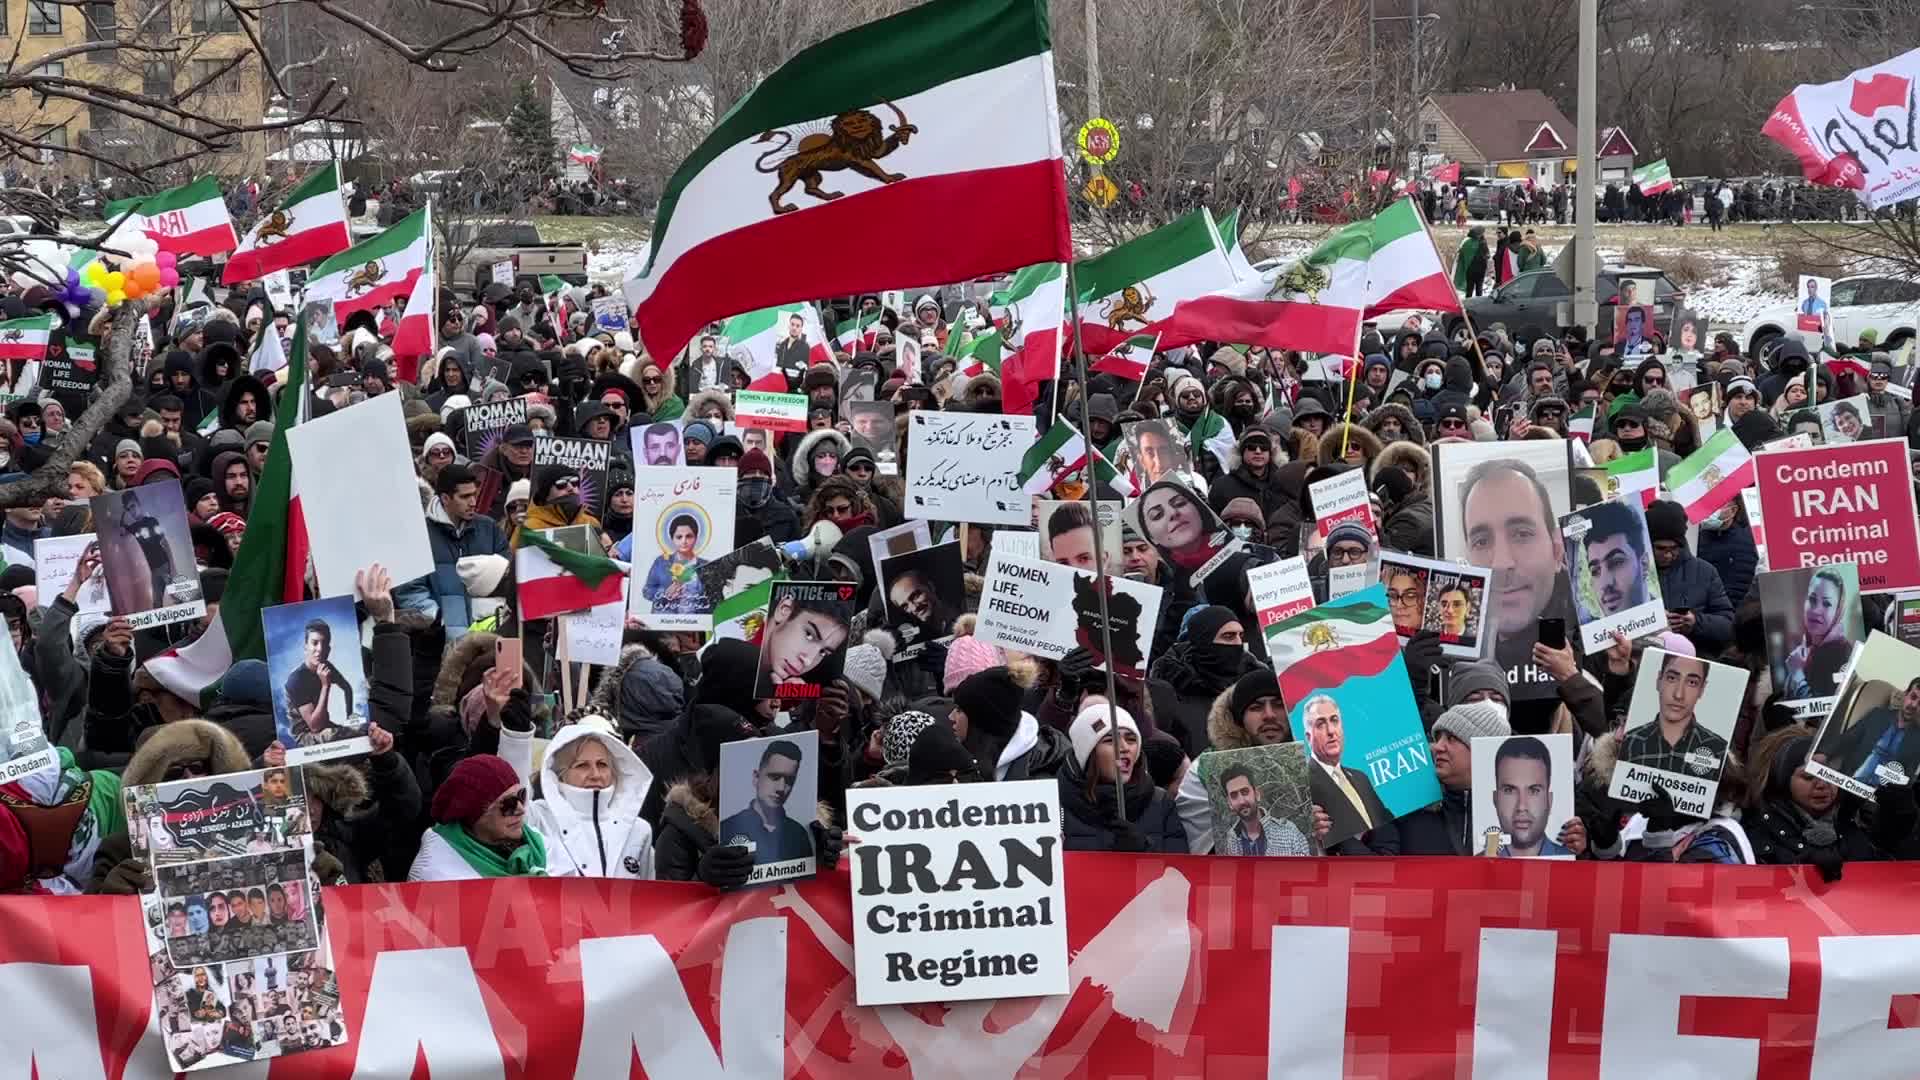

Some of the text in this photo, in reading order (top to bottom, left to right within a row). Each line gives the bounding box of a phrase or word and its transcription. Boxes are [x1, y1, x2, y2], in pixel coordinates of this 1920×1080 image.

[466, 400, 525, 421] WOMAN
[468, 415, 526, 432] LIFE FREEDOM
[535, 438, 608, 460] WOMAN
[1776, 459, 1889, 484] Condemn
[1316, 490, 1366, 512] every minute
[1792, 484, 1880, 518] IRAN
[1791, 519, 1889, 546] Criminal
[1799, 548, 1888, 569] Regime
[997, 562, 1051, 586] WOMEN,
[775, 585, 824, 601] JUSTICE
[1256, 581, 1309, 602] every minute
[126, 606, 196, 630] ehdi Valipour
[988, 598, 1051, 623] FREEDOM
[995, 621, 1008, 631] The
[1617, 612, 1657, 636] Eydivand
[996, 632, 1036, 647] IRANIAN
[7, 753, 51, 777] Ghadami
[1368, 742, 1428, 787] IRAN
[1817, 767, 1844, 786] Ahmad
[1626, 767, 1707, 796] Amirhossein
[1620, 784, 1705, 815] Davo Vand
[853, 798, 1050, 832] Condemn
[765, 861, 806, 878] Ahmadi
[855, 835, 1057, 896] IRAN
[866, 897, 1053, 934] Criminal
[885, 949, 1039, 987] Regime
